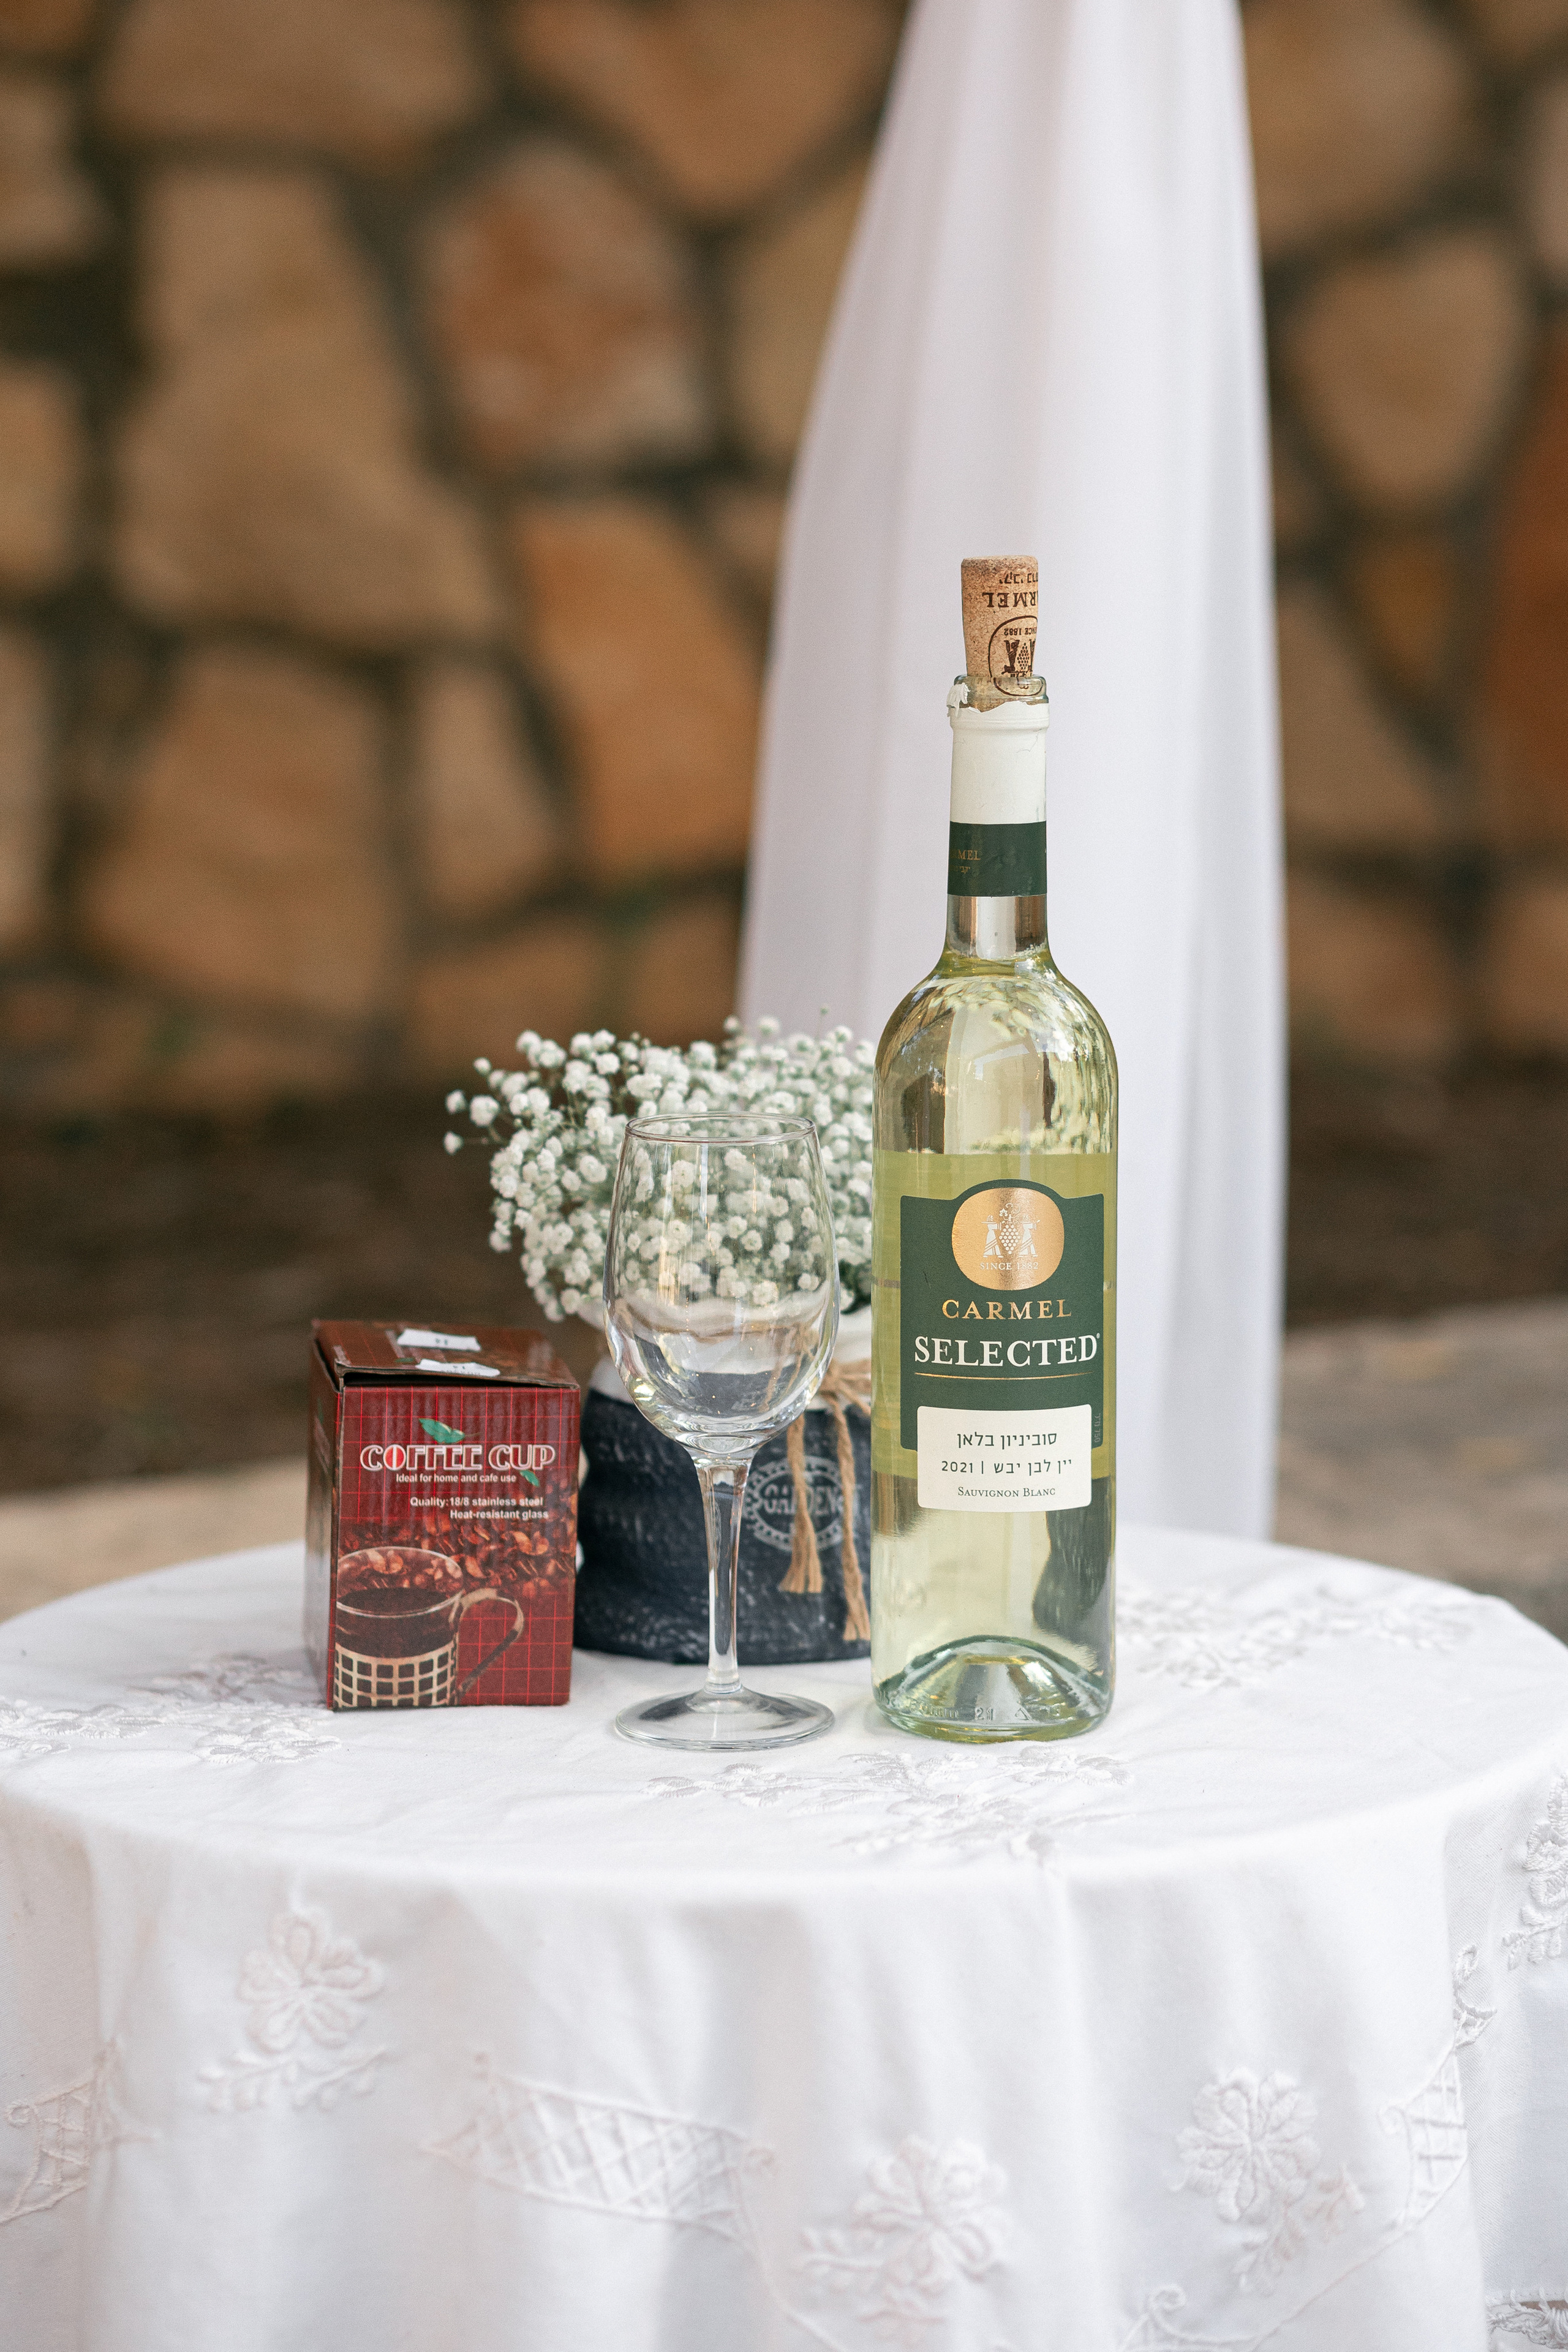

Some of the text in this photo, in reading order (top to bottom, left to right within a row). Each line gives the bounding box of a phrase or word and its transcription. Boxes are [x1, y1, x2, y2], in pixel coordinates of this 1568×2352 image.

[982, 591, 1038, 608] RMEL
[957, 849, 981, 861] MEL
[980, 1262, 1012, 1270] SINCE
[941, 1298, 1072, 1320] CARMEL
[956, 1431, 1057, 1450] סוביניון בלאן
[360, 1444, 556, 1471] COFFEE CUP
[941, 1458, 1072, 1476] יין לבן יבש 2021
[396, 1473, 418, 1483] Ideal
[420, 1473, 432, 1483] for
[434, 1473, 459, 1483] home
[460, 1473, 478, 1483] and
[479, 1473, 499, 1483] cafe
[472, 1497, 517, 1507] stainless
[519, 1497, 544, 1507] steel
[450, 1509, 549, 1521] Heat-resistant glass
